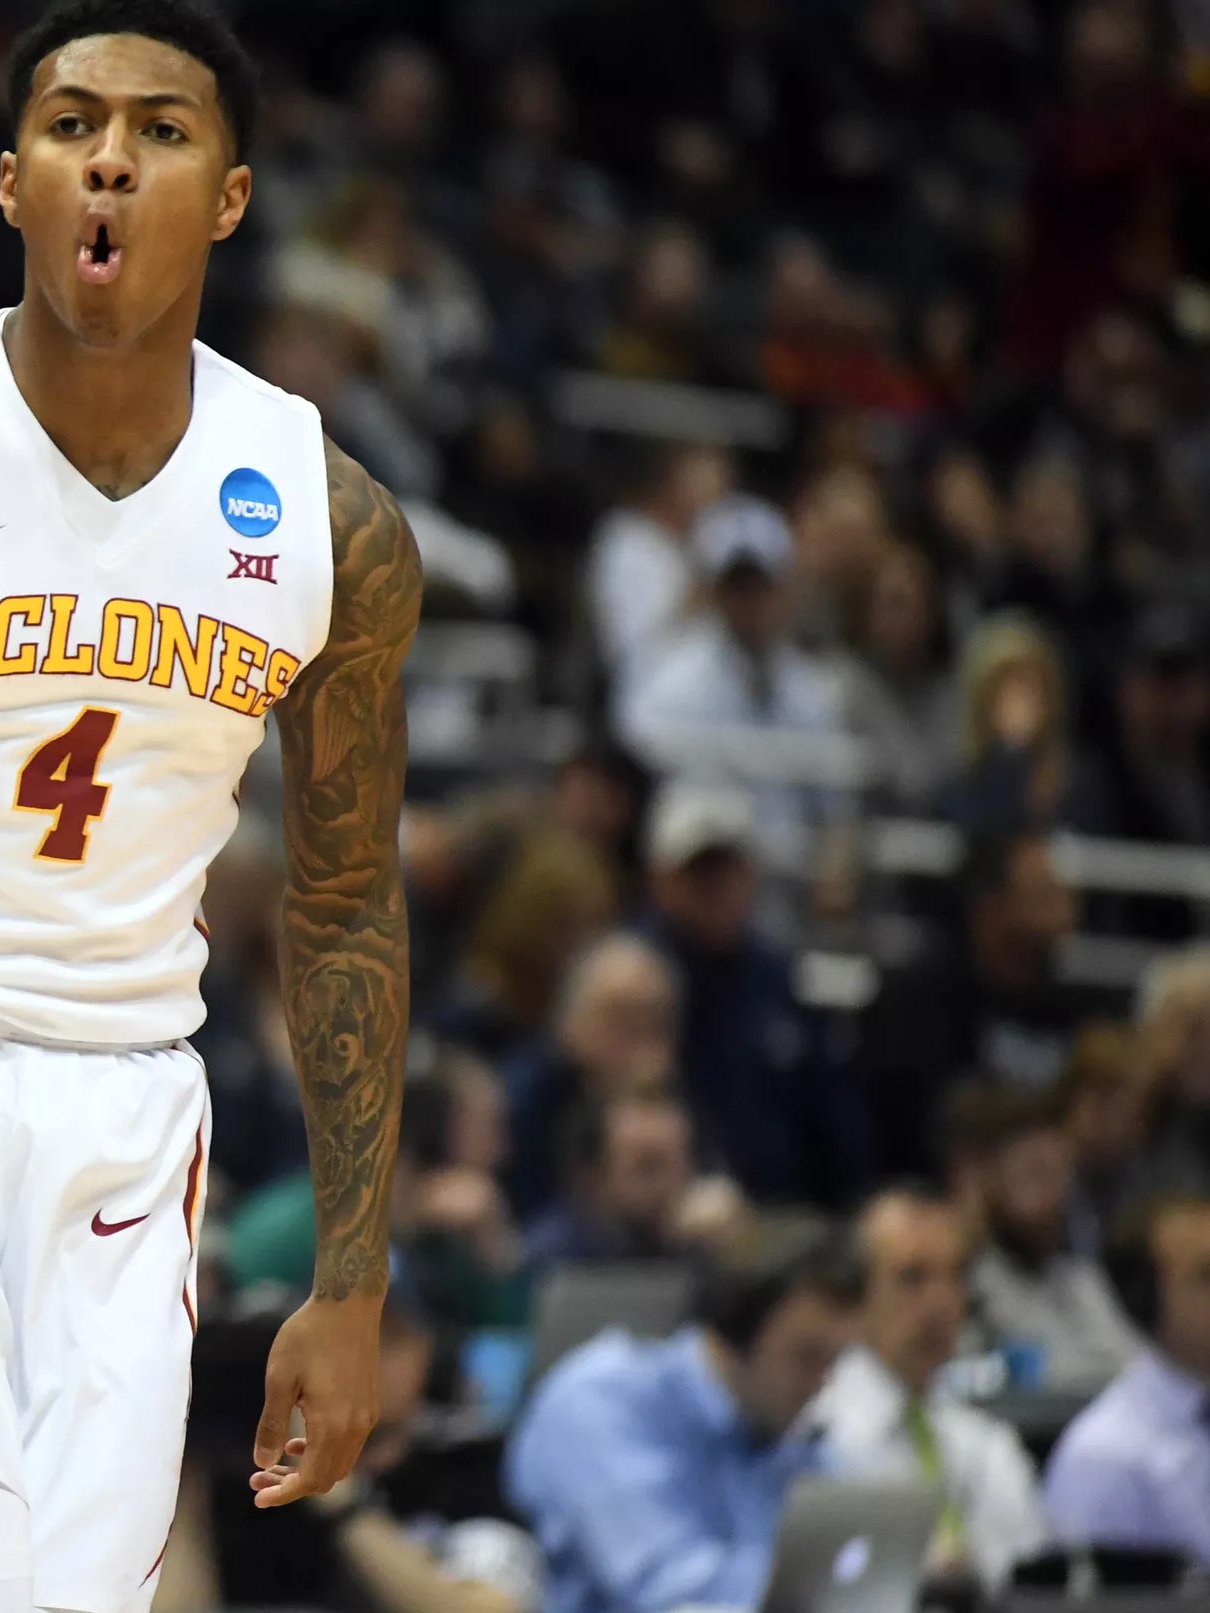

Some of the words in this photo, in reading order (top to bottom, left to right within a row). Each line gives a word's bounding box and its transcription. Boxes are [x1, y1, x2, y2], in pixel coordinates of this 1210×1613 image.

[227, 497, 279, 522] NCAA
[227, 548, 280, 585] XII
[13, 705, 122, 864] 4
